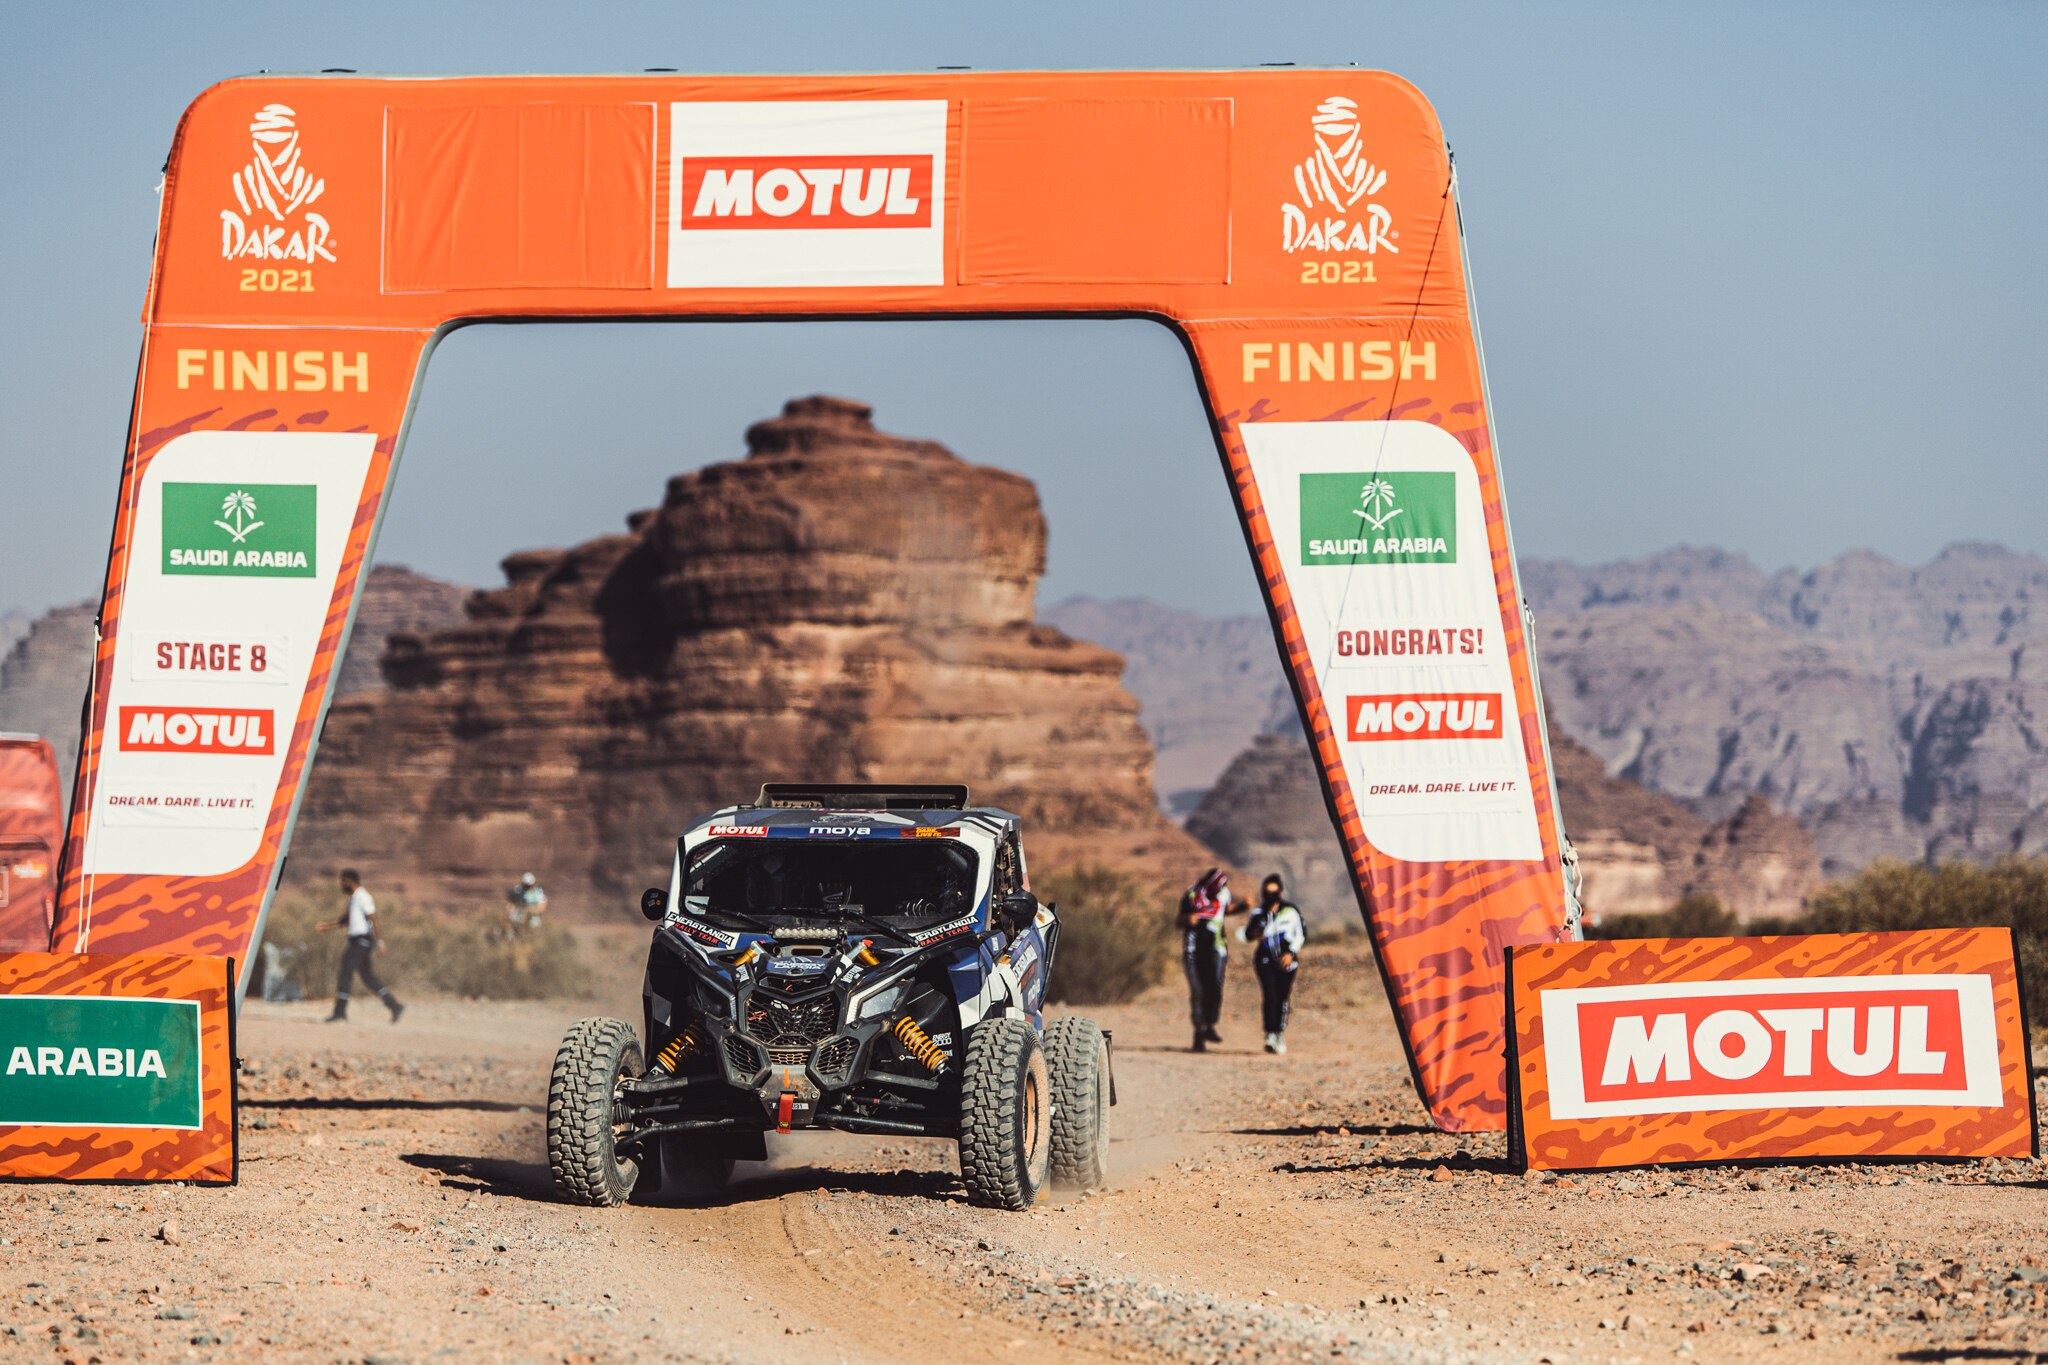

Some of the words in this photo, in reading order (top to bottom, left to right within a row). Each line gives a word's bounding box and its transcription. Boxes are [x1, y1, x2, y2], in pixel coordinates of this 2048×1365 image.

[692, 167, 920, 217] MOTUL
[220, 209, 336, 263] DAKAR
[1281, 202, 1399, 254] DAKAR
[240, 269, 315, 292] 2021
[1301, 261, 1377, 284] 2021
[177, 349, 369, 393] FINISH
[1242, 340, 1437, 383] FINISH
[169, 549, 228, 567] SAUDI
[233, 550, 308, 568] ARABIA
[1309, 538, 1368, 555] SAUDI
[1372, 537, 1447, 554] ARABIA
[157, 642, 241, 672] STAGE
[250, 645, 267, 672] 8
[1337, 628, 1484, 657] CONGRATS!
[127, 712, 267, 748] MOTUL
[1355, 700, 1495, 733] MOTUL
[109, 796, 161, 806] DREAM.
[164, 796, 204, 807] DARE.
[207, 798, 237, 808] LIVE
[239, 798, 255, 808] IT.
[1370, 784, 1422, 795] DREAM.
[1425, 782, 1465, 793] DARE.
[1468, 782, 1498, 792] LIVE
[1501, 781, 1516, 791] IT.
[711, 826, 765, 835] MOTUL
[809, 826, 871, 838] moya
[667, 913, 732, 945] ENERGYLANDIA
[674, 922, 698, 935] RALLY
[699, 931, 719, 945] TEAM
[920, 934, 945, 947] RALLY
[946, 925, 970, 936] TEAM
[1600, 1005, 1947, 1086] MOTUL
[5, 1046, 168, 1079] ARABIA
